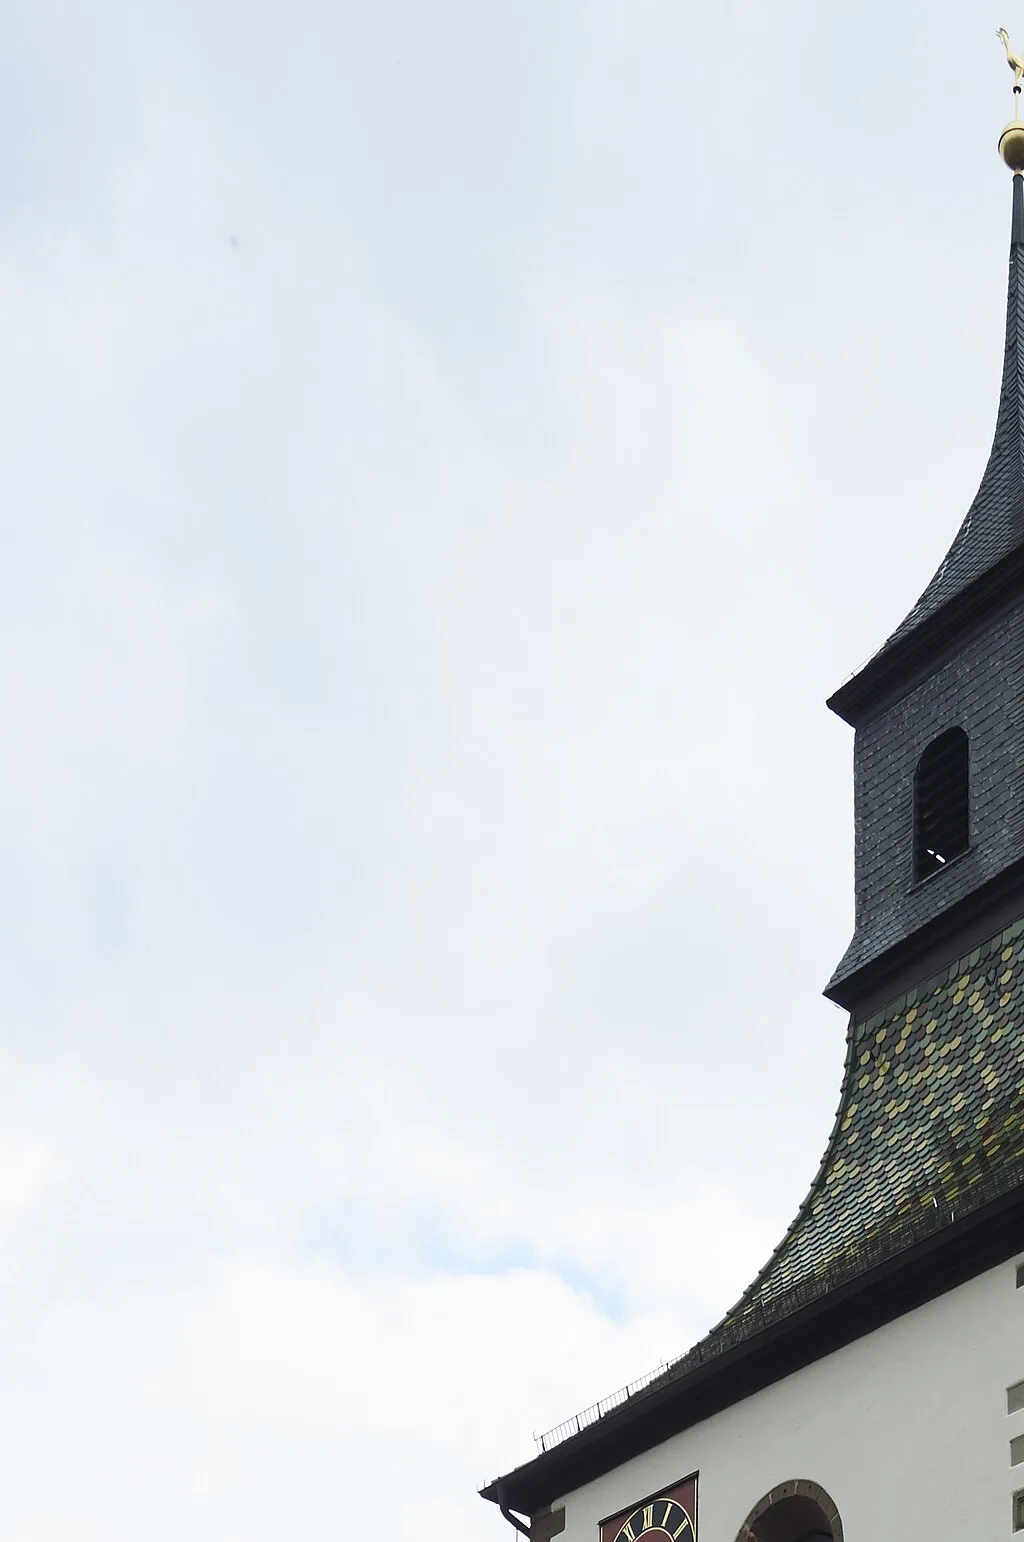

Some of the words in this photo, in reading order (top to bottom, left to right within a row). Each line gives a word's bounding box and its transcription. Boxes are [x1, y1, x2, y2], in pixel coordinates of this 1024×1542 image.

[642, 1504, 654, 1531] XII
[660, 1503, 673, 1528] I
[672, 1517, 689, 1541] II
